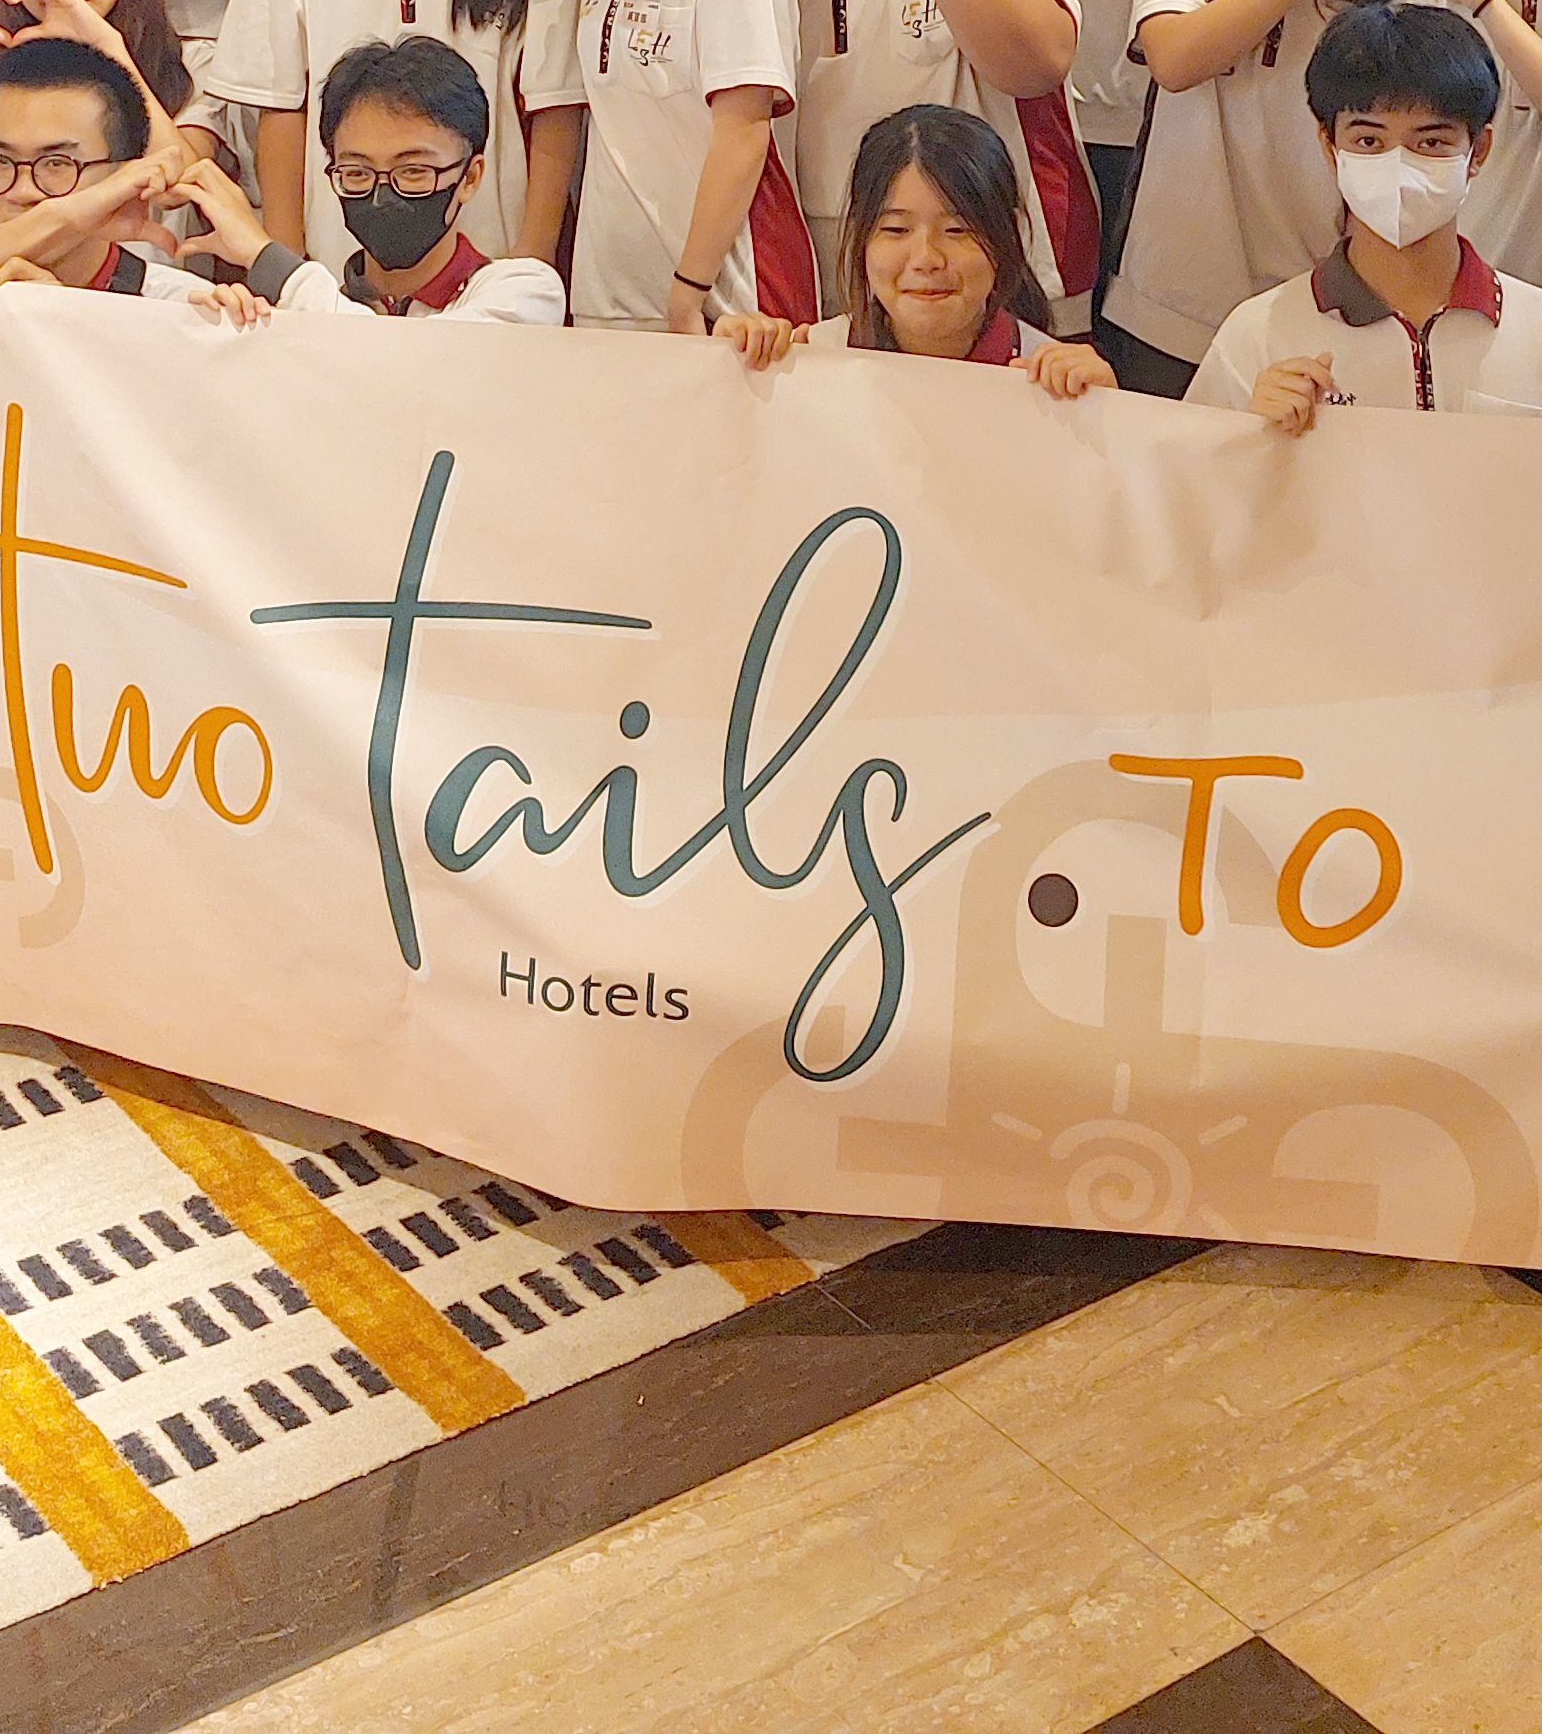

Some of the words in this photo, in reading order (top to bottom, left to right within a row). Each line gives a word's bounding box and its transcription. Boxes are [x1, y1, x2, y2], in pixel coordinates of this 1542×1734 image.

[249, 449, 992, 1082] tails
[1108, 753, 1402, 949] To
[500, 950, 690, 1022] Hotels
